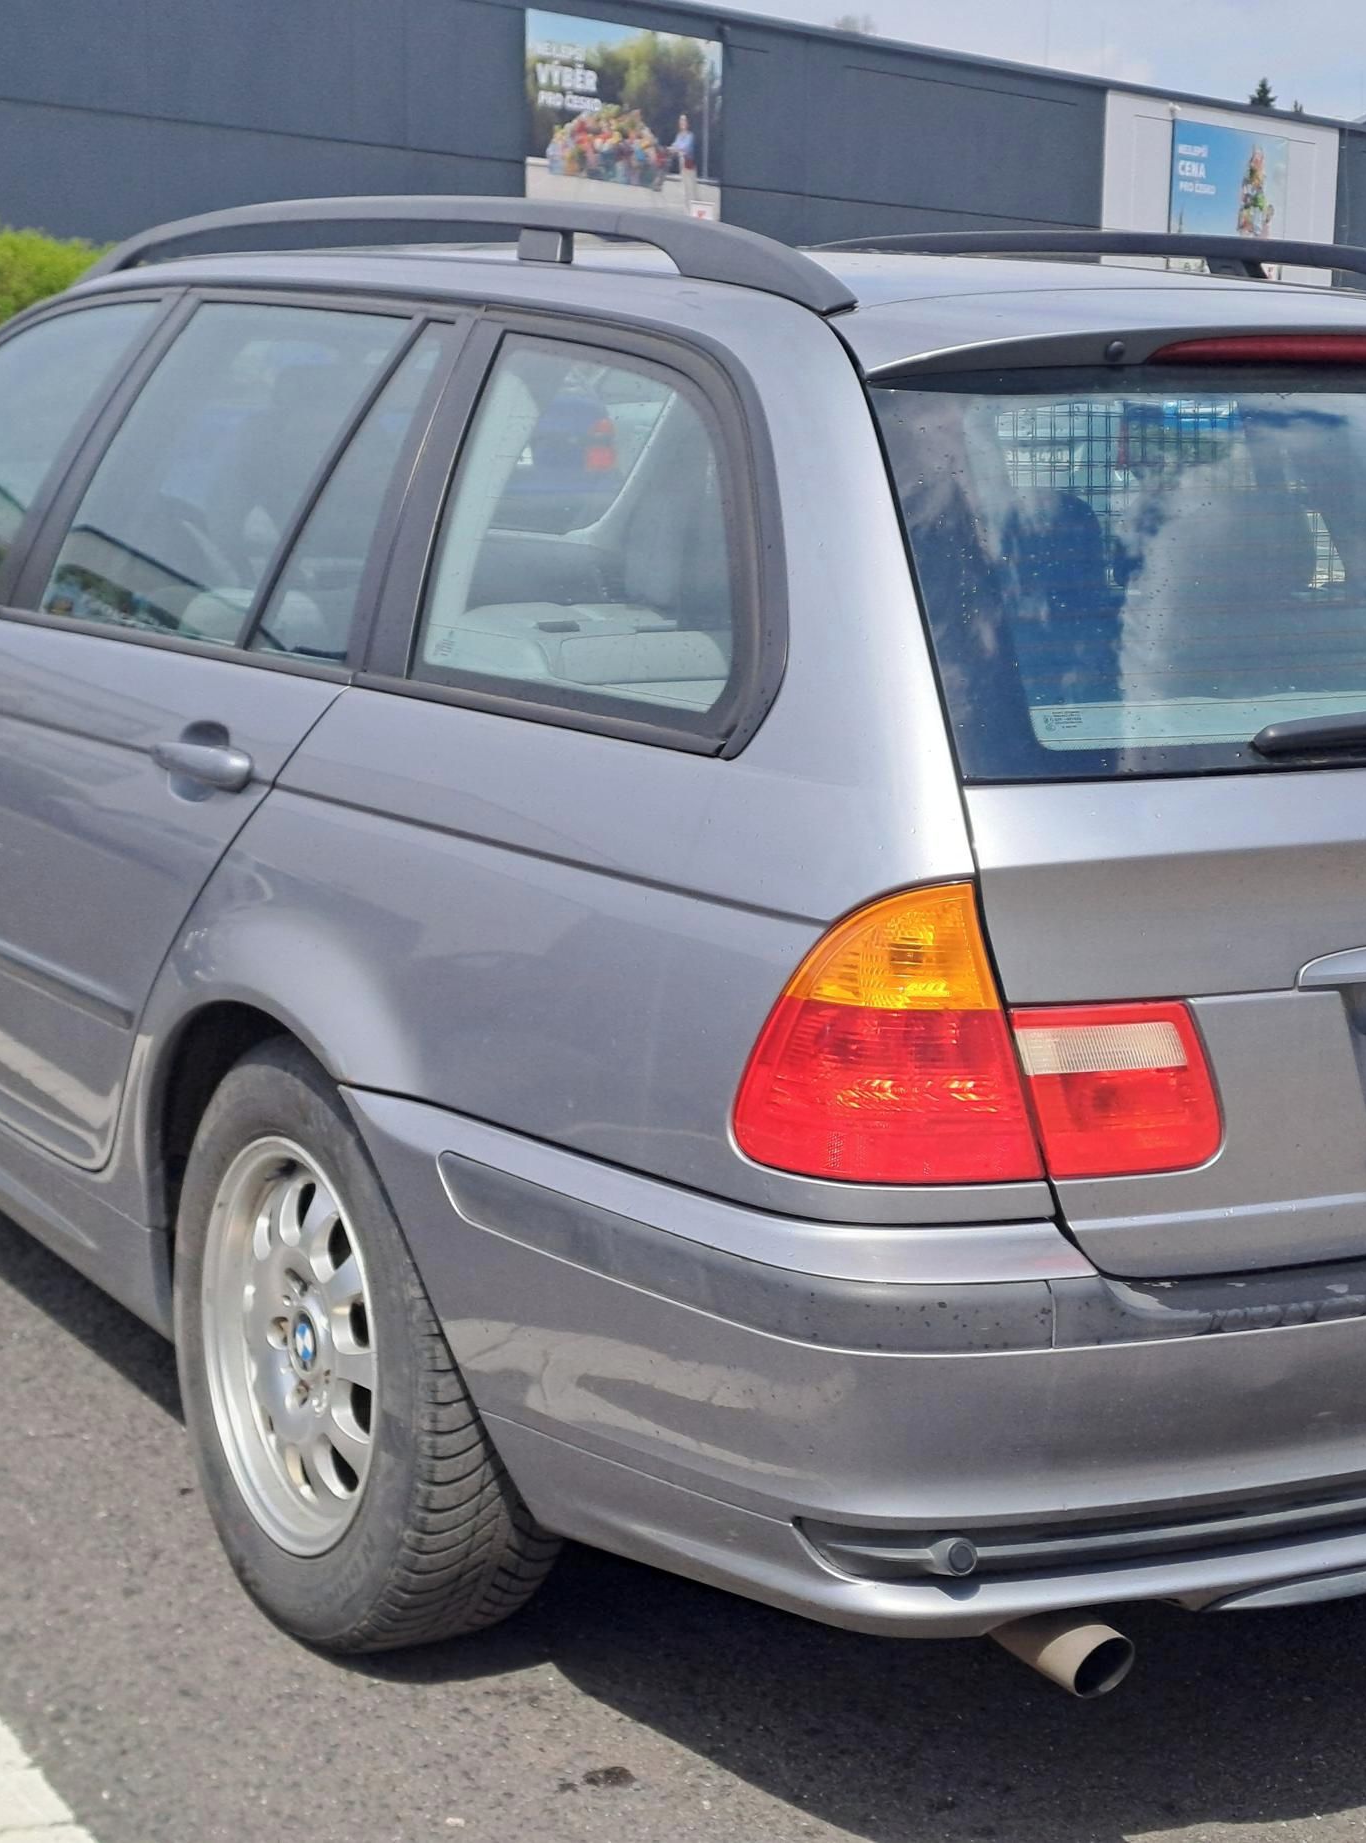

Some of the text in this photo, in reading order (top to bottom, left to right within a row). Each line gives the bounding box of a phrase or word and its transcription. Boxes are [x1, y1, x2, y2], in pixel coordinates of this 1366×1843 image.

[536, 60, 598, 92] VÝBĚR
[537, 90, 563, 107] PRO
[1178, 160, 1206, 179] CENA
